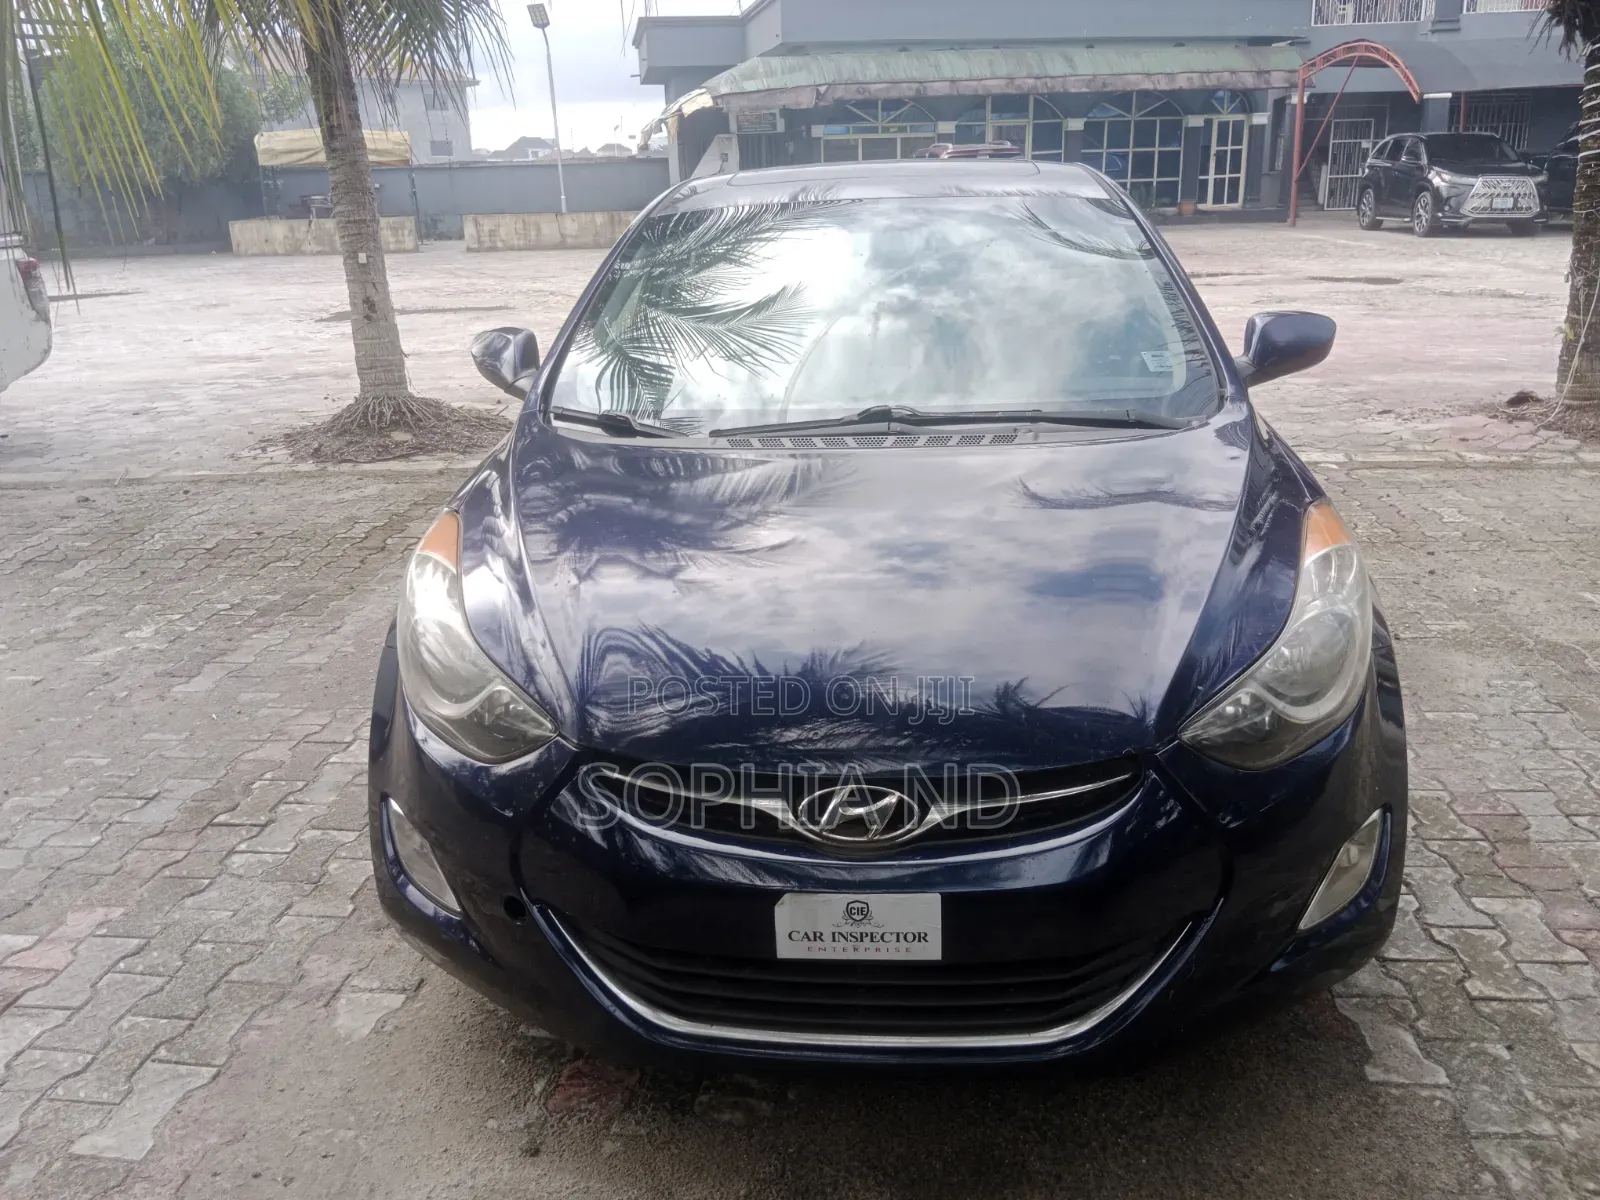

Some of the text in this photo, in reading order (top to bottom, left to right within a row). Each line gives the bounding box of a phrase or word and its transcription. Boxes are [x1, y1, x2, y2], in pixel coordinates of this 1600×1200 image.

[849, 906, 867, 916] CIE
[788, 930, 929, 943] CAR INSPECTOR
